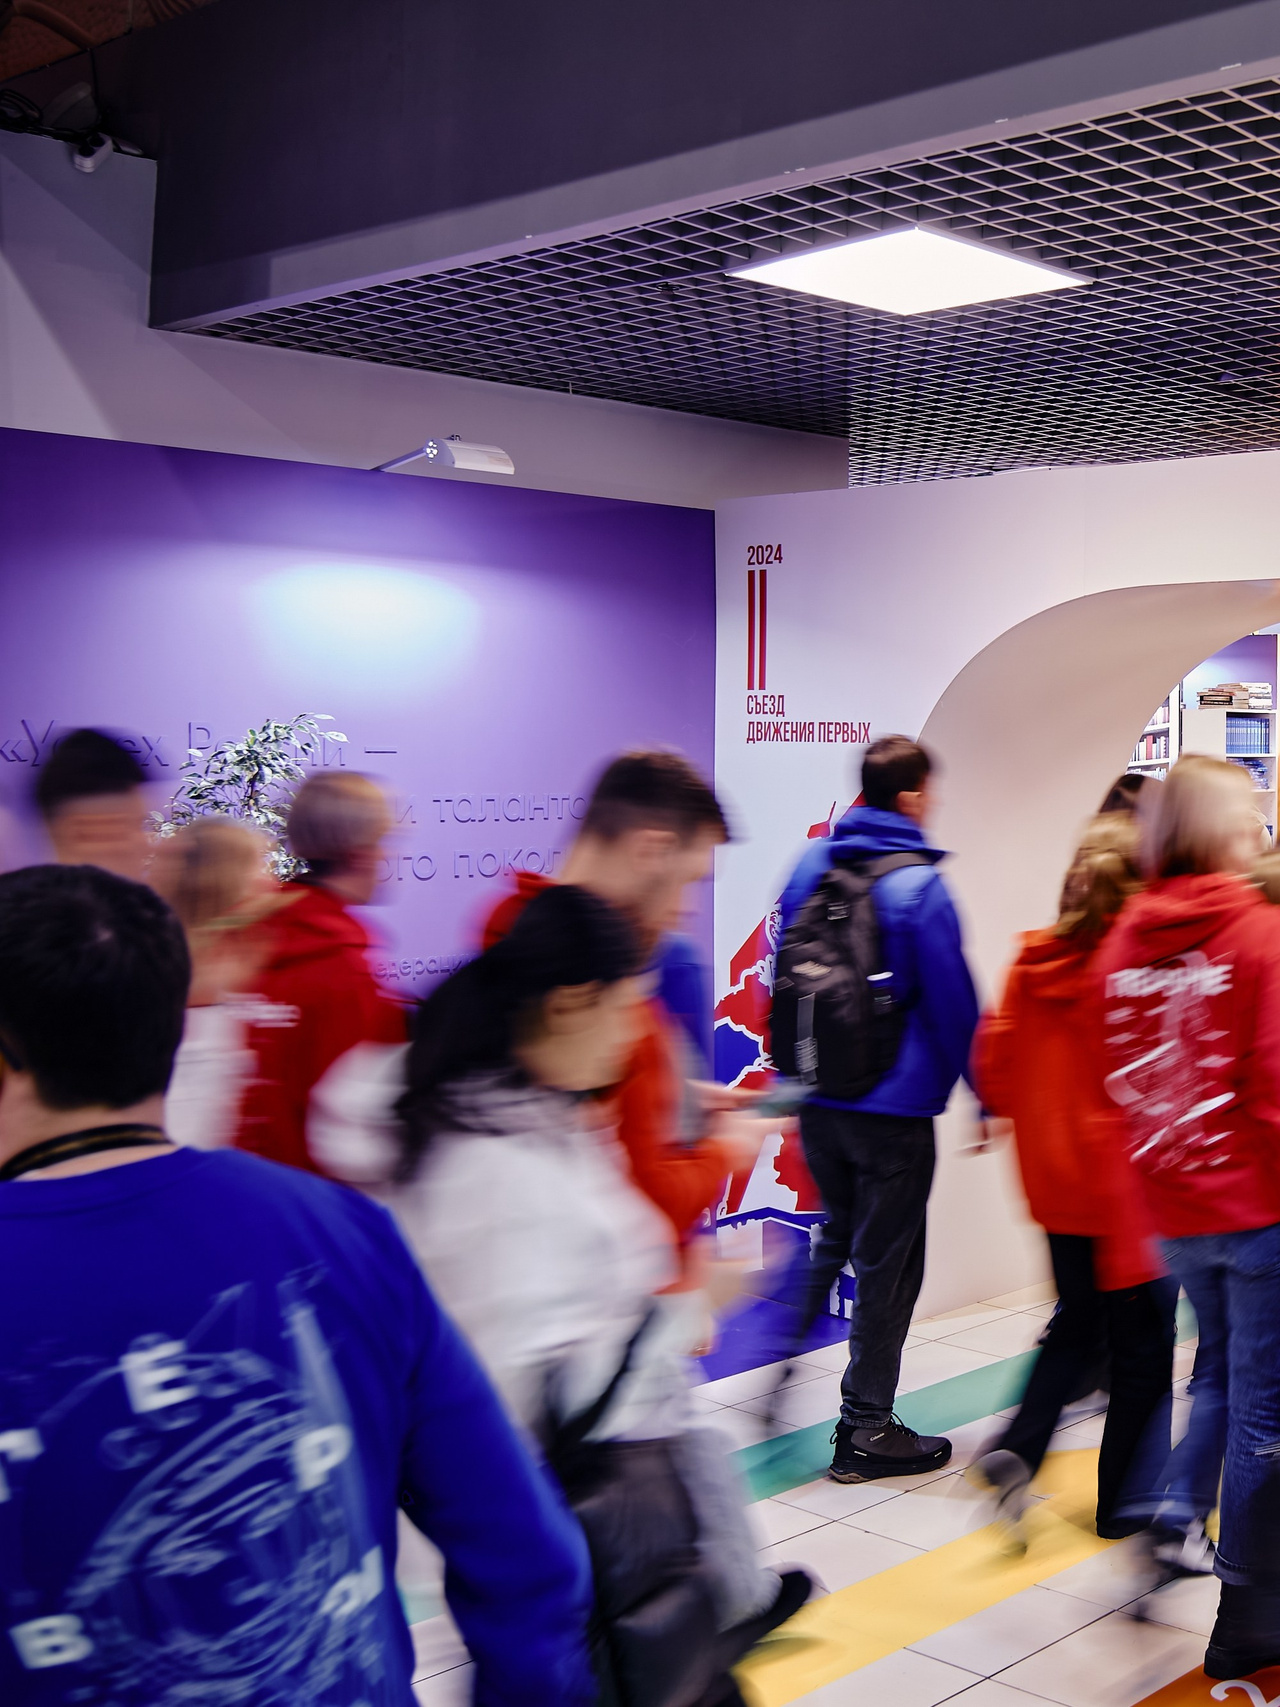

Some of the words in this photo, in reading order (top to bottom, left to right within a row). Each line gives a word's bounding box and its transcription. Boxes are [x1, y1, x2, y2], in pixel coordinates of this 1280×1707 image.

[747, 544, 783, 566] 2024
[746, 695, 785, 717] СЪЕЗД
[746, 721, 814, 744] ДВИЖЕНИЯ
[818, 722, 871, 744] ПЕРВЫХ
